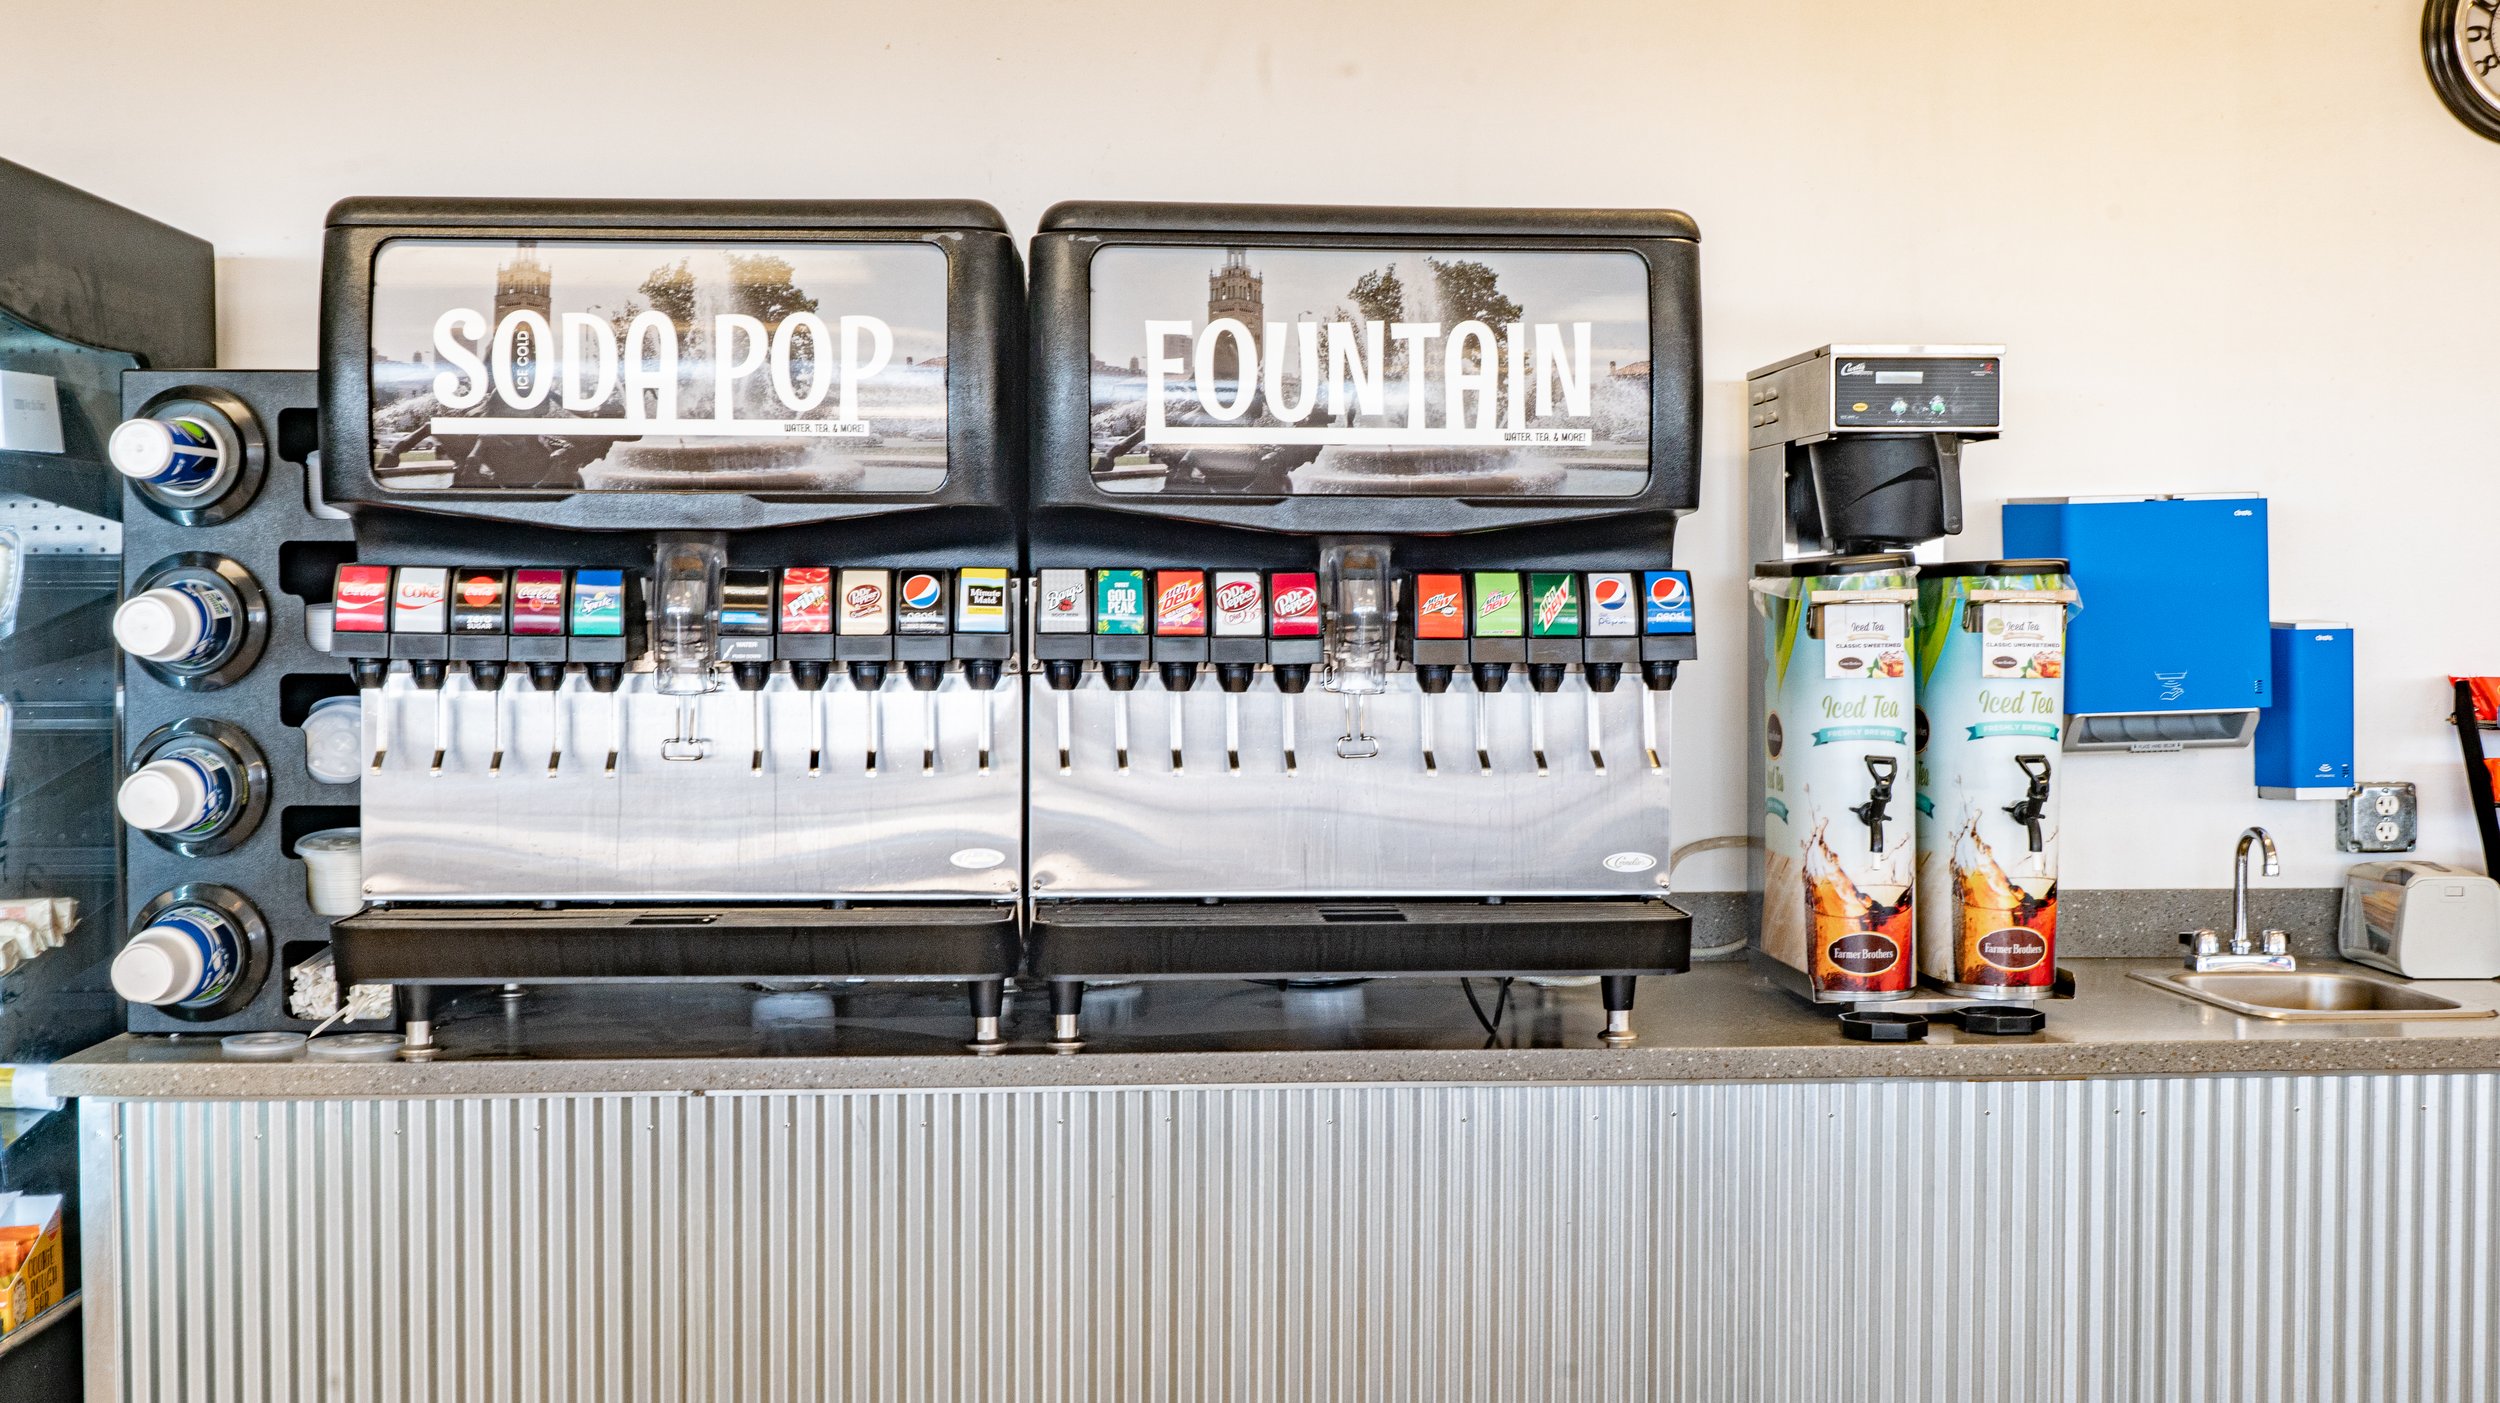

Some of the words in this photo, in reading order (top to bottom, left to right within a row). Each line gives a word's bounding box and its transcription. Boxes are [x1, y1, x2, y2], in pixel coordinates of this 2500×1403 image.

[516, 330, 530, 367] COLD
[433, 308, 678, 420] SODA
[715, 311, 894, 420] POP
[516, 367, 530, 390] ICE
[1145, 317, 1592, 433] FOUNTAIN
[833, 424, 838, 432] &
[840, 424, 865, 432] MORE!
[1554, 432, 1559, 442] &
[1561, 432, 1586, 442] MORE!
[402, 585, 440, 598] Coke
[970, 588, 1001, 598] Minute
[1107, 589, 1136, 601] GOLD
[1233, 585, 1246, 597] Dr
[1290, 590, 1304, 602] Dr
[582, 597, 616, 613] Sprite
[787, 585, 825, 617] Pibb
[974, 596, 998, 605] Maid
[1221, 589, 1255, 611] Pepper
[1277, 593, 1313, 616] Pepper
[1107, 601, 1137, 613] PEAK
[1656, 610, 1686, 623] pepsi
[1851, 622, 1870, 632] Iced
[1872, 621, 1885, 632] Tea
[2006, 621, 2025, 631] Iced
[2027, 621, 2040, 631] Tea
[1822, 695, 1867, 719] Iced
[1873, 695, 1899, 719] Tea
[1978, 689, 2024, 715] Iced
[2030, 690, 2055, 715] Tea
[1827, 729, 1862, 738] FRESHLY
[1864, 729, 1896, 738] BREWED
[1983, 724, 2020, 732] FRESHLY
[2021, 724, 2052, 733] BREWED
[1834, 948, 1861, 960] Farmer
[1862, 949, 1894, 960] Brothers
[1985, 942, 2012, 954] Farmer
[2012, 943, 2043, 955] Brothers
[28, 1244, 55, 1279] COOKIE
[30, 1265, 58, 1300] DOUGH
